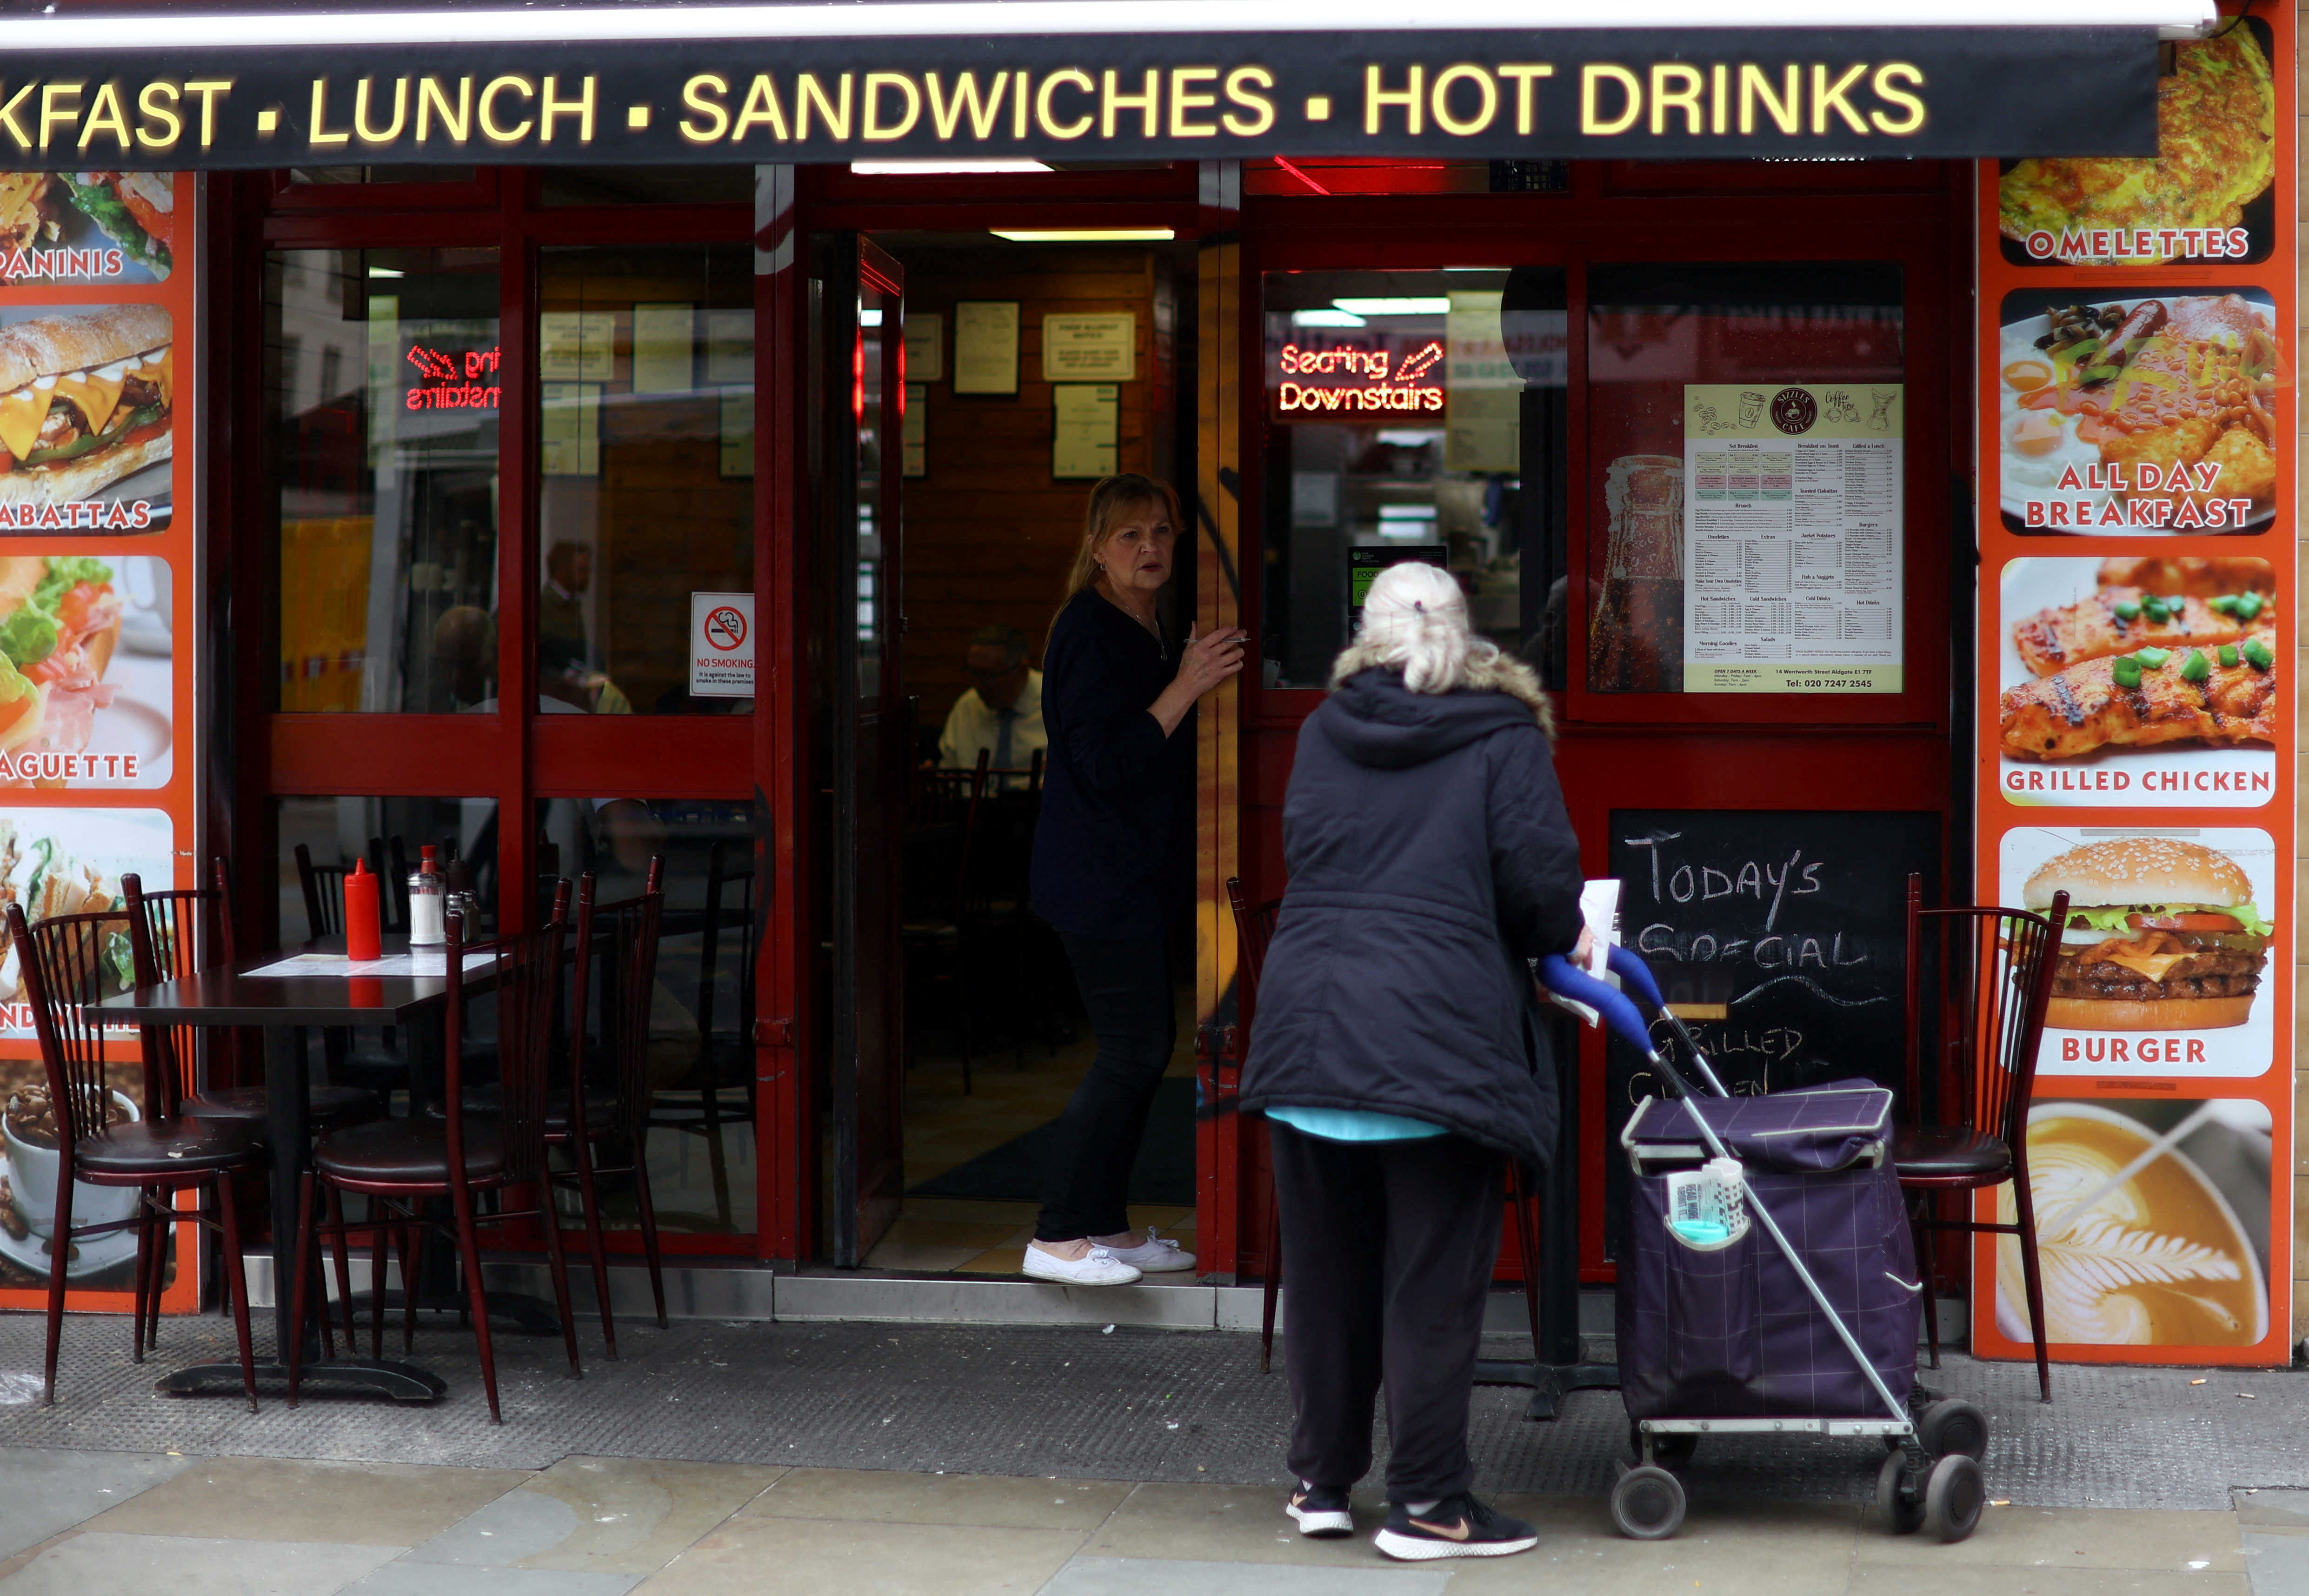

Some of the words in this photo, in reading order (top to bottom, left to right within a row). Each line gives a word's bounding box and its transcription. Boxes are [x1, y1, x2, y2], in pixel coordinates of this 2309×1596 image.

[309, 74, 596, 143] LUNCH
[679, 66, 1274, 141] SANDWICHES
[1365, 64, 1553, 135] HOT
[1582, 63, 1925, 134] DRINKS
[2025, 226, 2249, 260] OMELETTES
[0, 246, 123, 281] ANINIS
[1280, 343, 1389, 380] Seating
[1280, 382, 1444, 411] Downstairs
[1777, 391, 1810, 403] SIZZLES
[1825, 390, 1849, 407] Coffee
[2056, 461, 2129, 492] ALL
[2137, 461, 2222, 492] DAY
[2024, 496, 2252, 528] BREAKFAST
[697, 658, 709, 667] NO
[2005, 770, 2131, 791] GRILLED
[2142, 770, 2270, 791] CHICKEN
[1625, 832, 1824, 932] TODAY'S
[2062, 1037, 2207, 1064] BURGER
